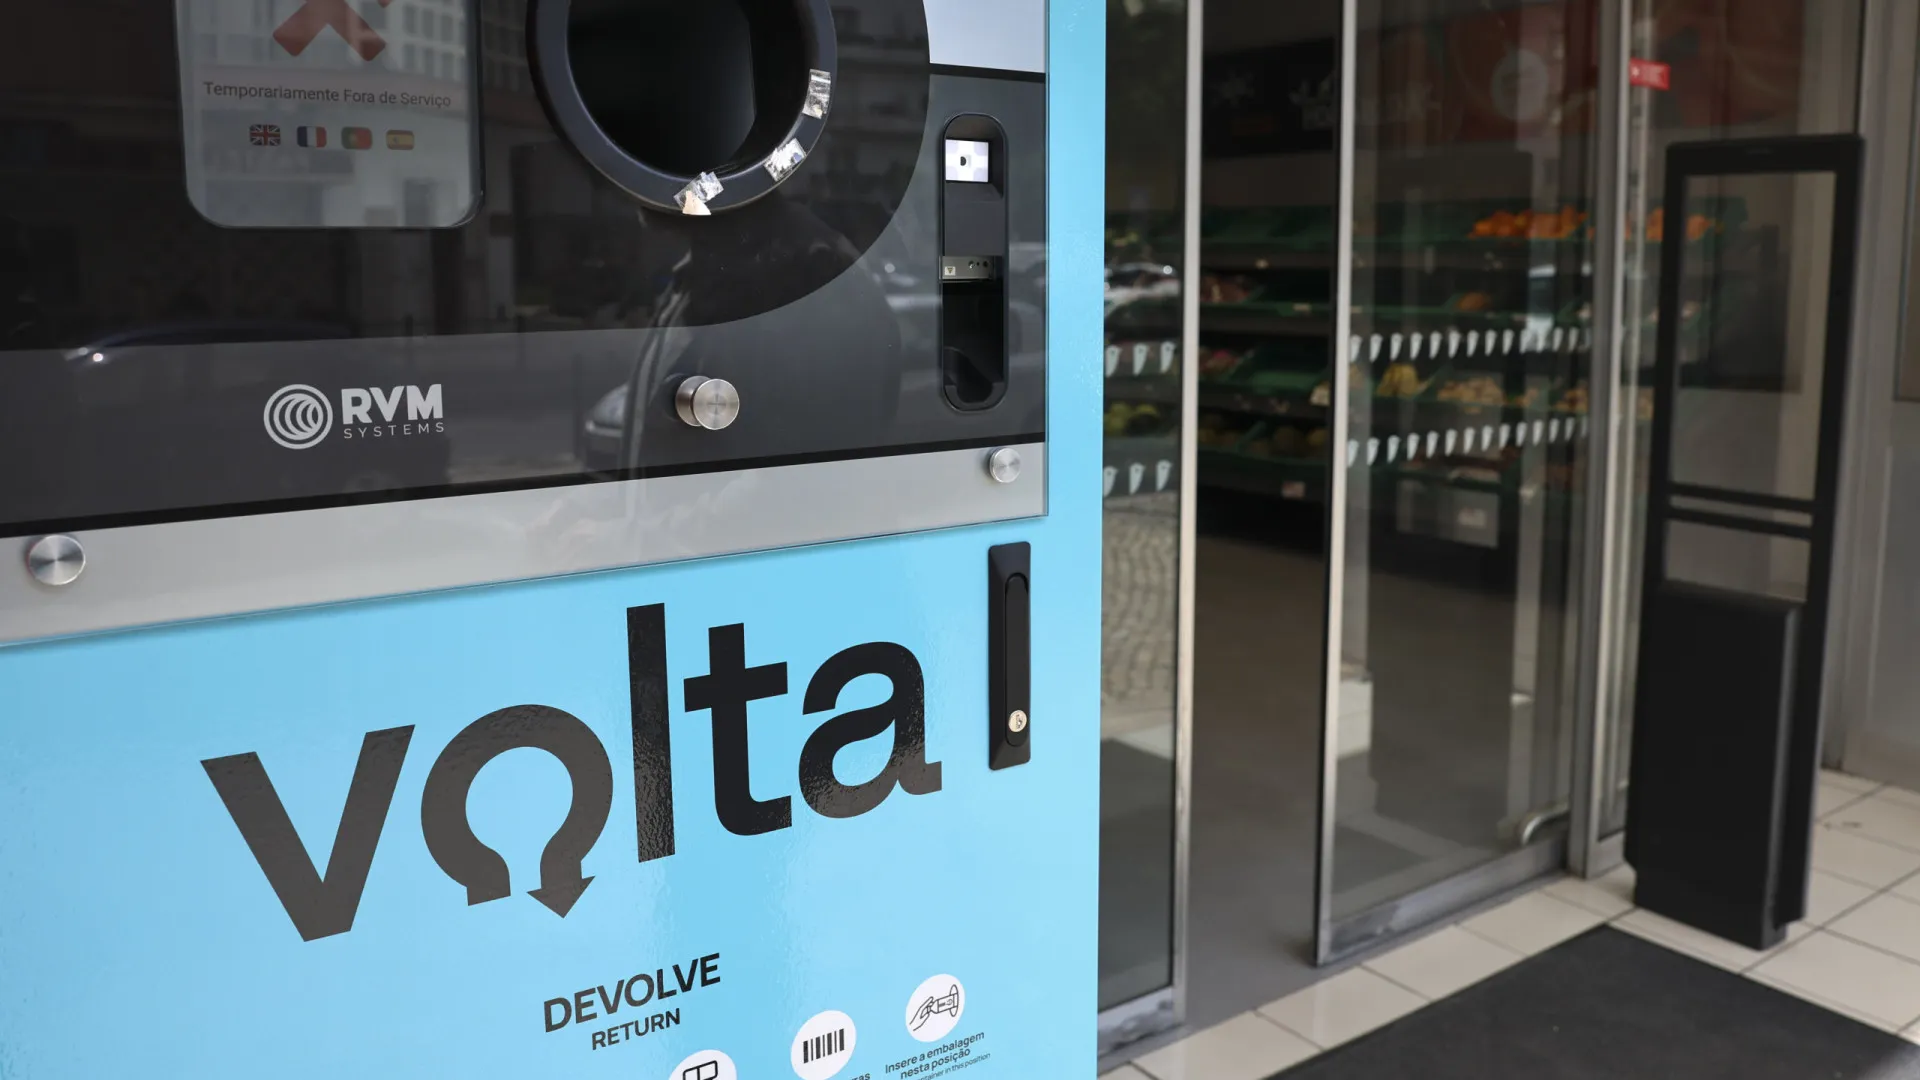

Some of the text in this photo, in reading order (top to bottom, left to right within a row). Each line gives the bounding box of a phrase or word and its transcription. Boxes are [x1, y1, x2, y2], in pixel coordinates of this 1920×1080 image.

[203, 81, 451, 107] Temporariamente Fora de Serviço
[341, 384, 443, 425] RVM
[344, 422, 444, 439] SYSTEMS
[200, 602, 942, 942] volta
[544, 952, 720, 1033] DEVOLVE
[591, 1007, 681, 1051] RETURN
[885, 1032, 985, 1074] Insere a embalagem
[900, 1048, 971, 1080] nesta posição
[964, 1052, 991, 1069] position
